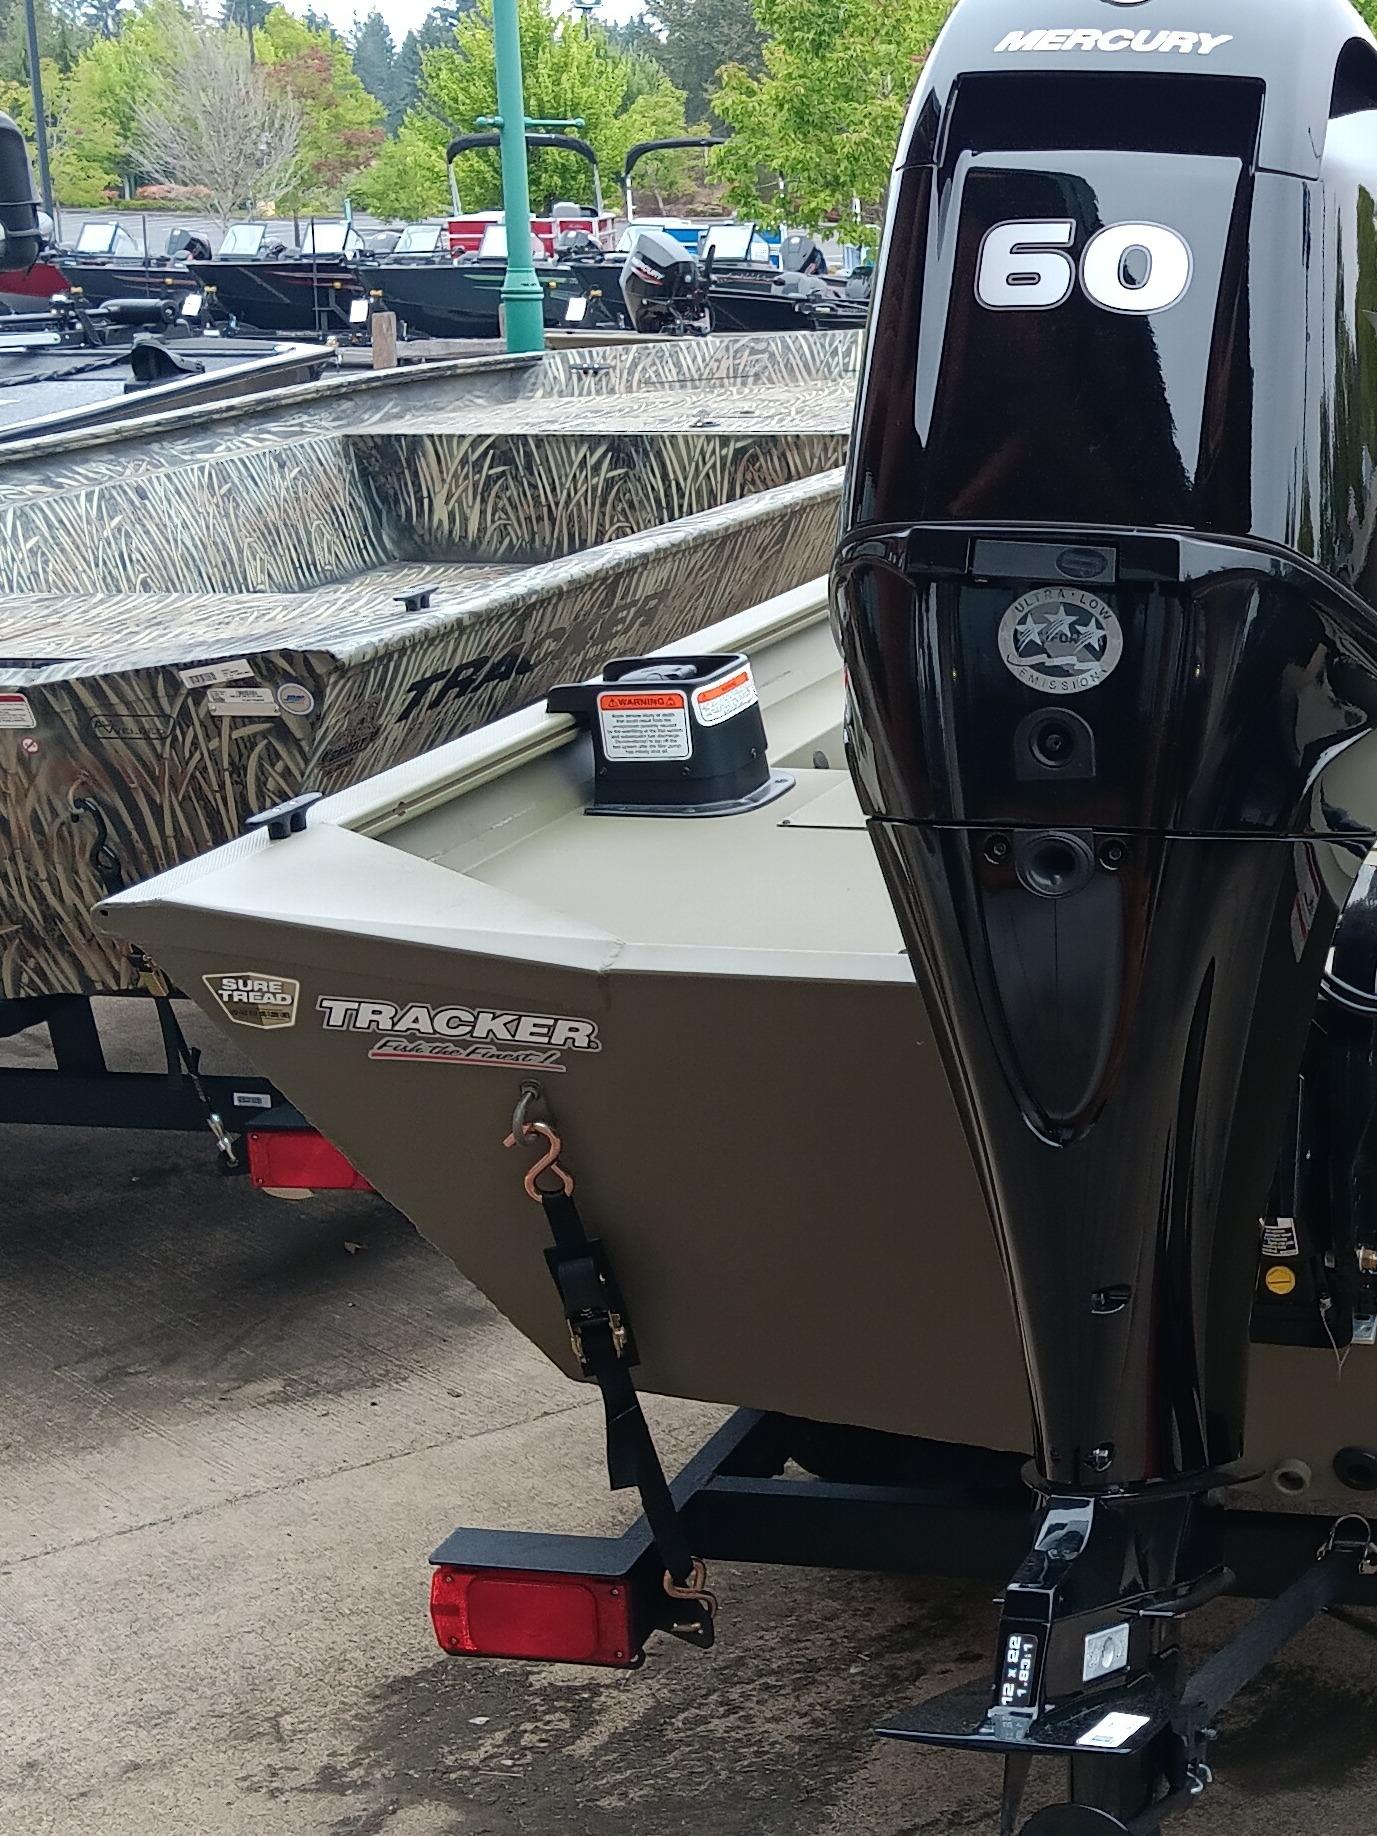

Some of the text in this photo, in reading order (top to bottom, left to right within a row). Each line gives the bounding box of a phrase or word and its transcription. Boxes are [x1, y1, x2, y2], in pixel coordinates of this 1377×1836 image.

[993, 28, 1234, 54] MERCURY
[974, 218, 1194, 316] 60
[1014, 588, 1112, 620] ULTRA LOW
[617, 697, 665, 706] WARNING
[221, 977, 282, 993] SURE
[217, 990, 293, 1005] TREAD
[319, 997, 595, 1049] TRACKER
[376, 1039, 424, 1055] Fish
[426, 1041, 463, 1057] the
[1007, 1636, 1021, 1663] 22
[1001, 1683, 1015, 1706] 12
